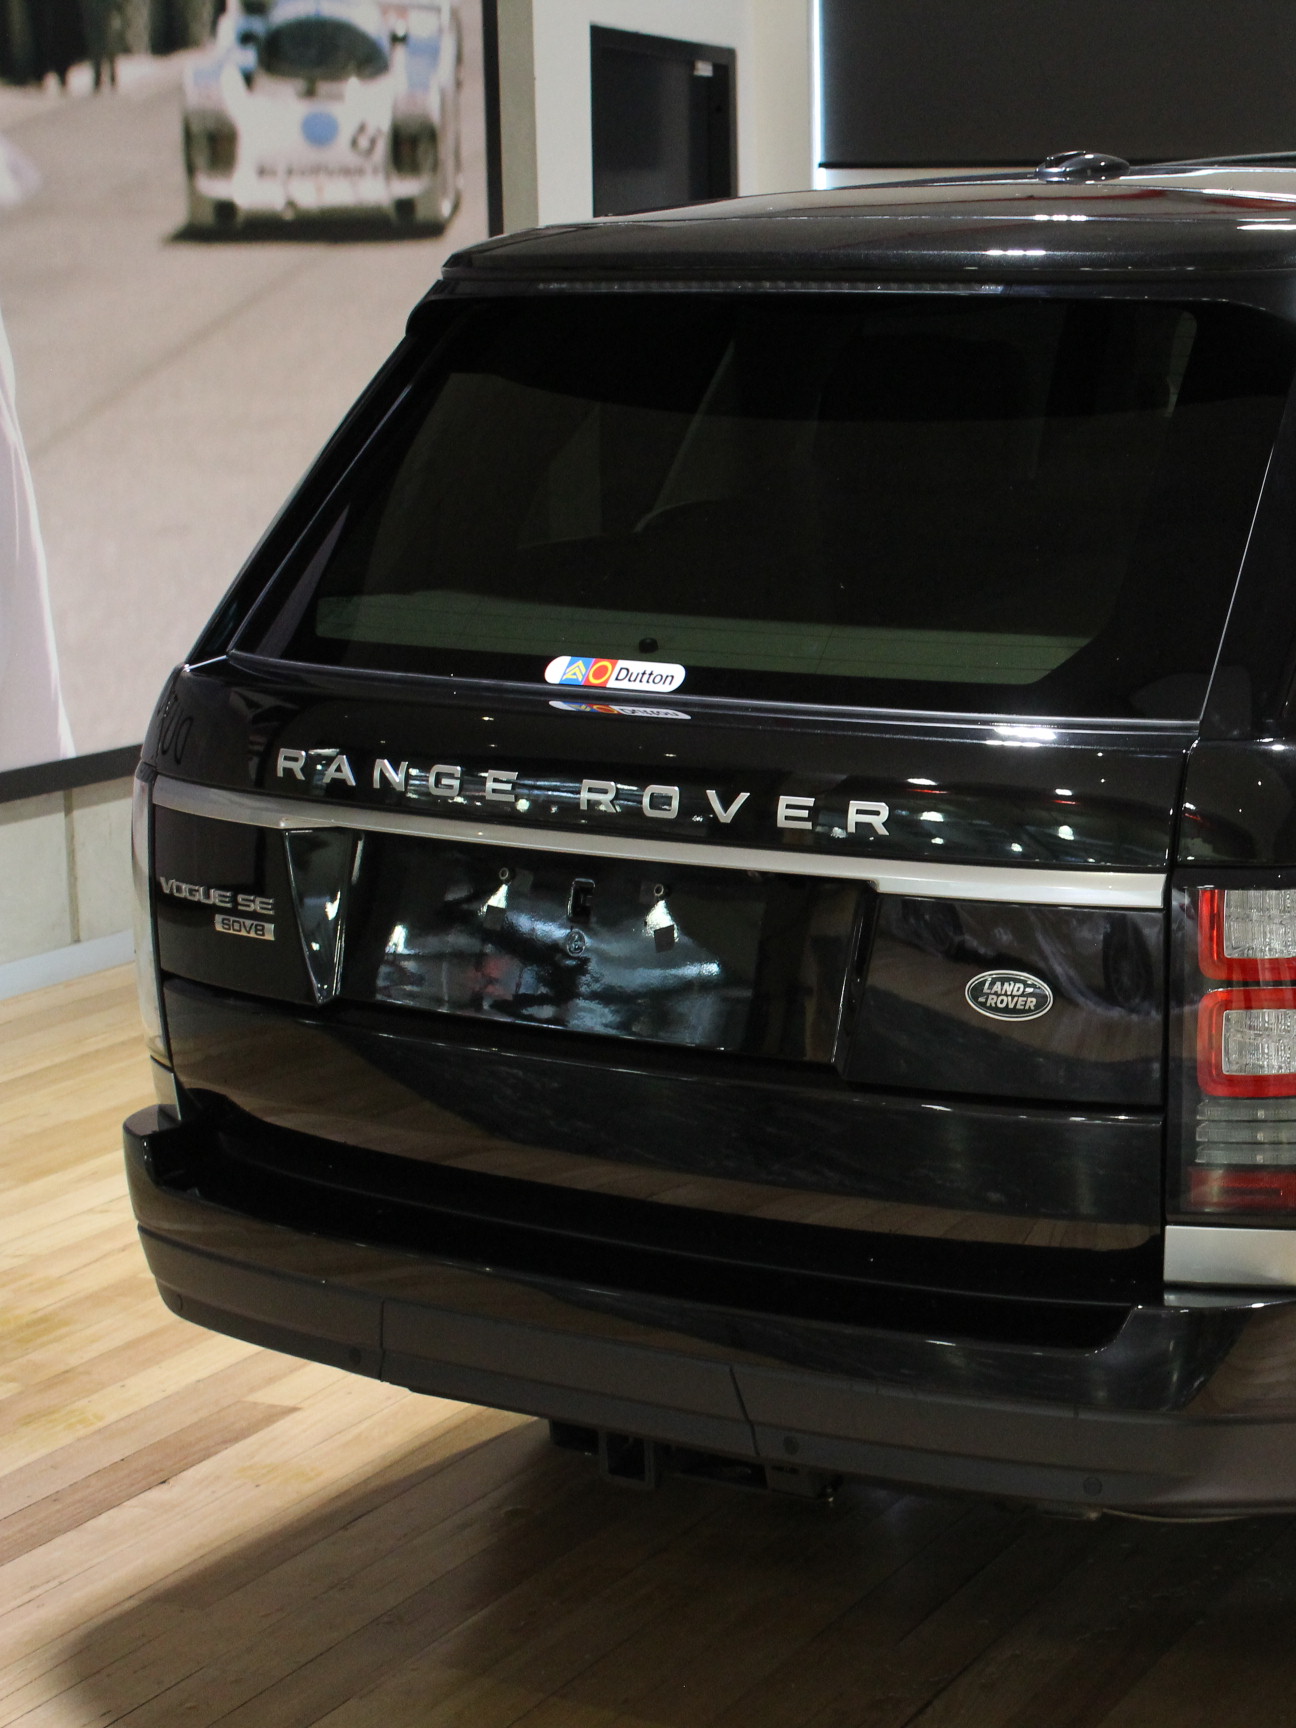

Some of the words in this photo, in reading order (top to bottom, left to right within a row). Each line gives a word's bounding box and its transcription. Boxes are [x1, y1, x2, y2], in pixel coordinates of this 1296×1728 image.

[615, 667, 675, 686] Dutton
[276, 748, 519, 803] RANGE
[579, 778, 890, 836] ROVER
[160, 876, 233, 909] VOGUE
[237, 893, 275, 915] SE
[221, 917, 266, 938] SDV8
[983, 978, 1025, 996] LAND
[986, 994, 1037, 1010] ROVER
